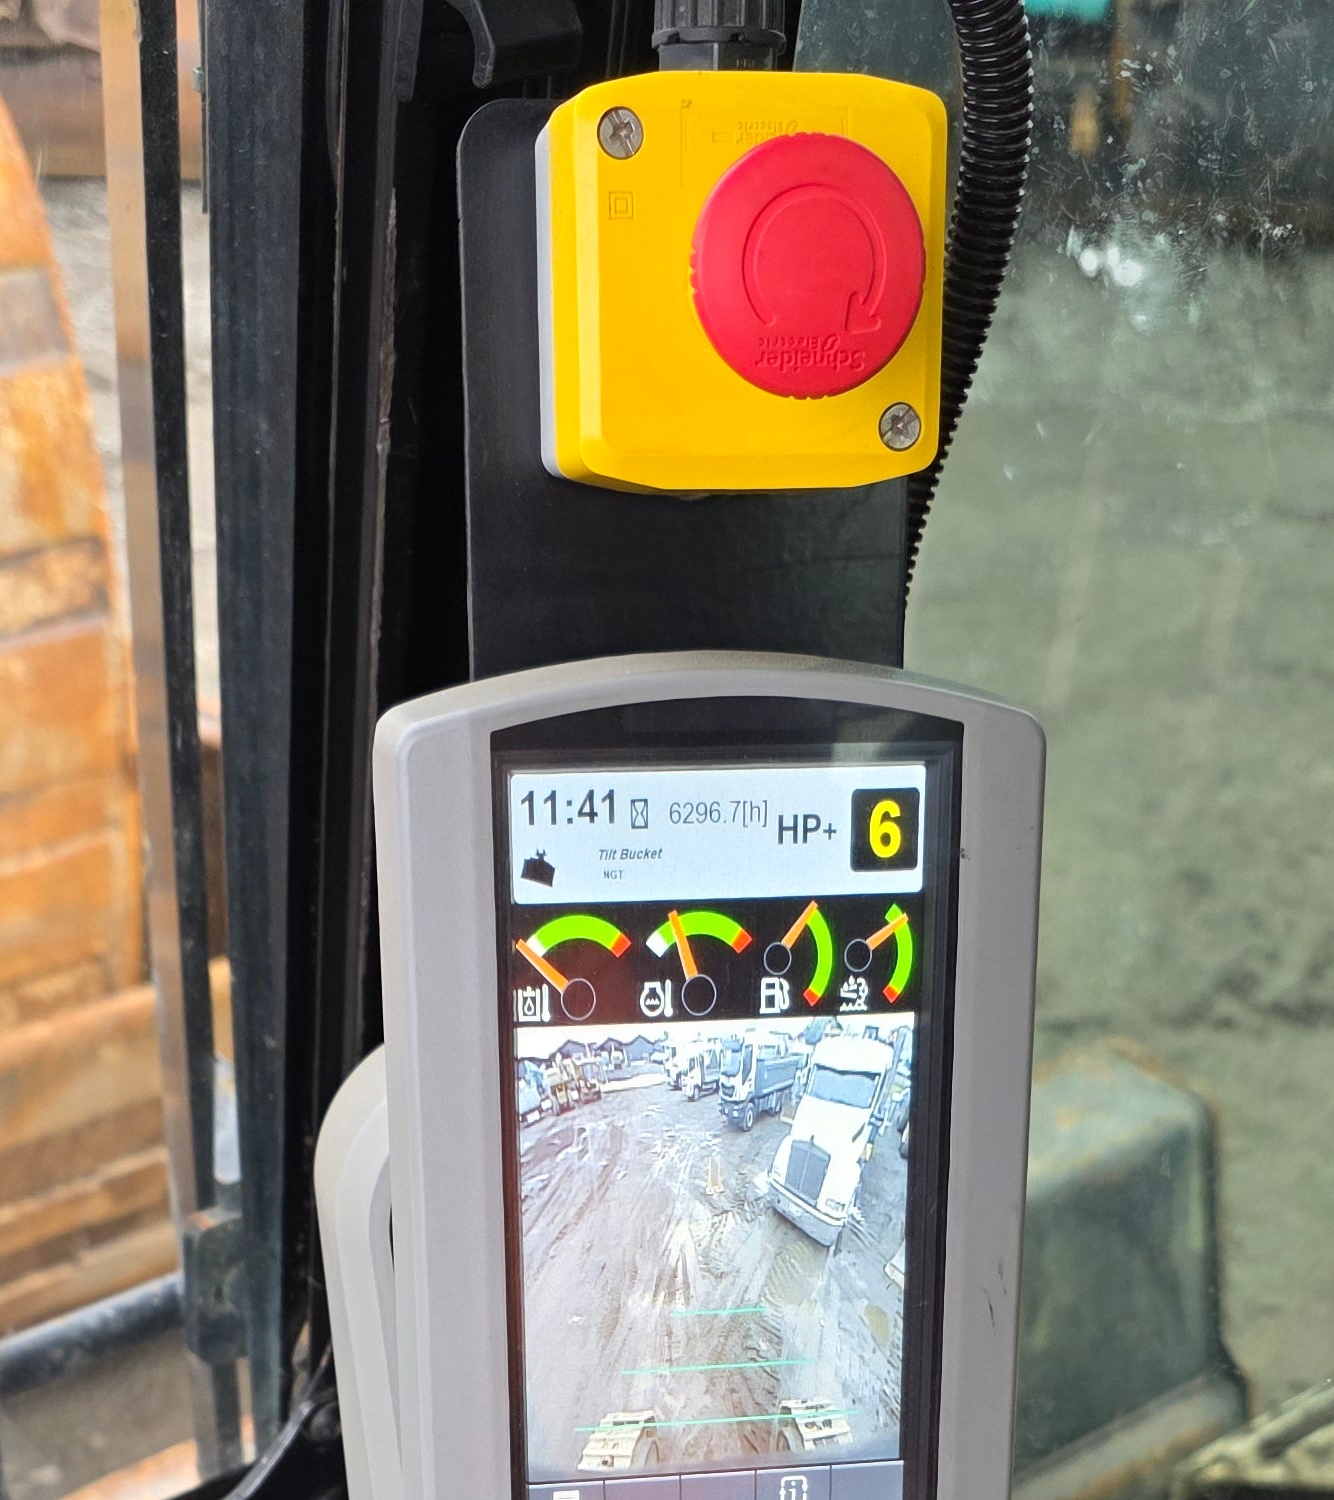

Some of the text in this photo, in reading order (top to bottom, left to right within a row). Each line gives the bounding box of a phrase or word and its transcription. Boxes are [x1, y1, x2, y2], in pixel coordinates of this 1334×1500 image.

[755, 348, 866, 373] Schneider
[519, 789, 615, 826] 11:41
[668, 799, 768, 828] 6296.7[h]
[777, 813, 837, 845] HP+
[868, 800, 902, 858] 6
[598, 847, 663, 861] Tilt Bucket
